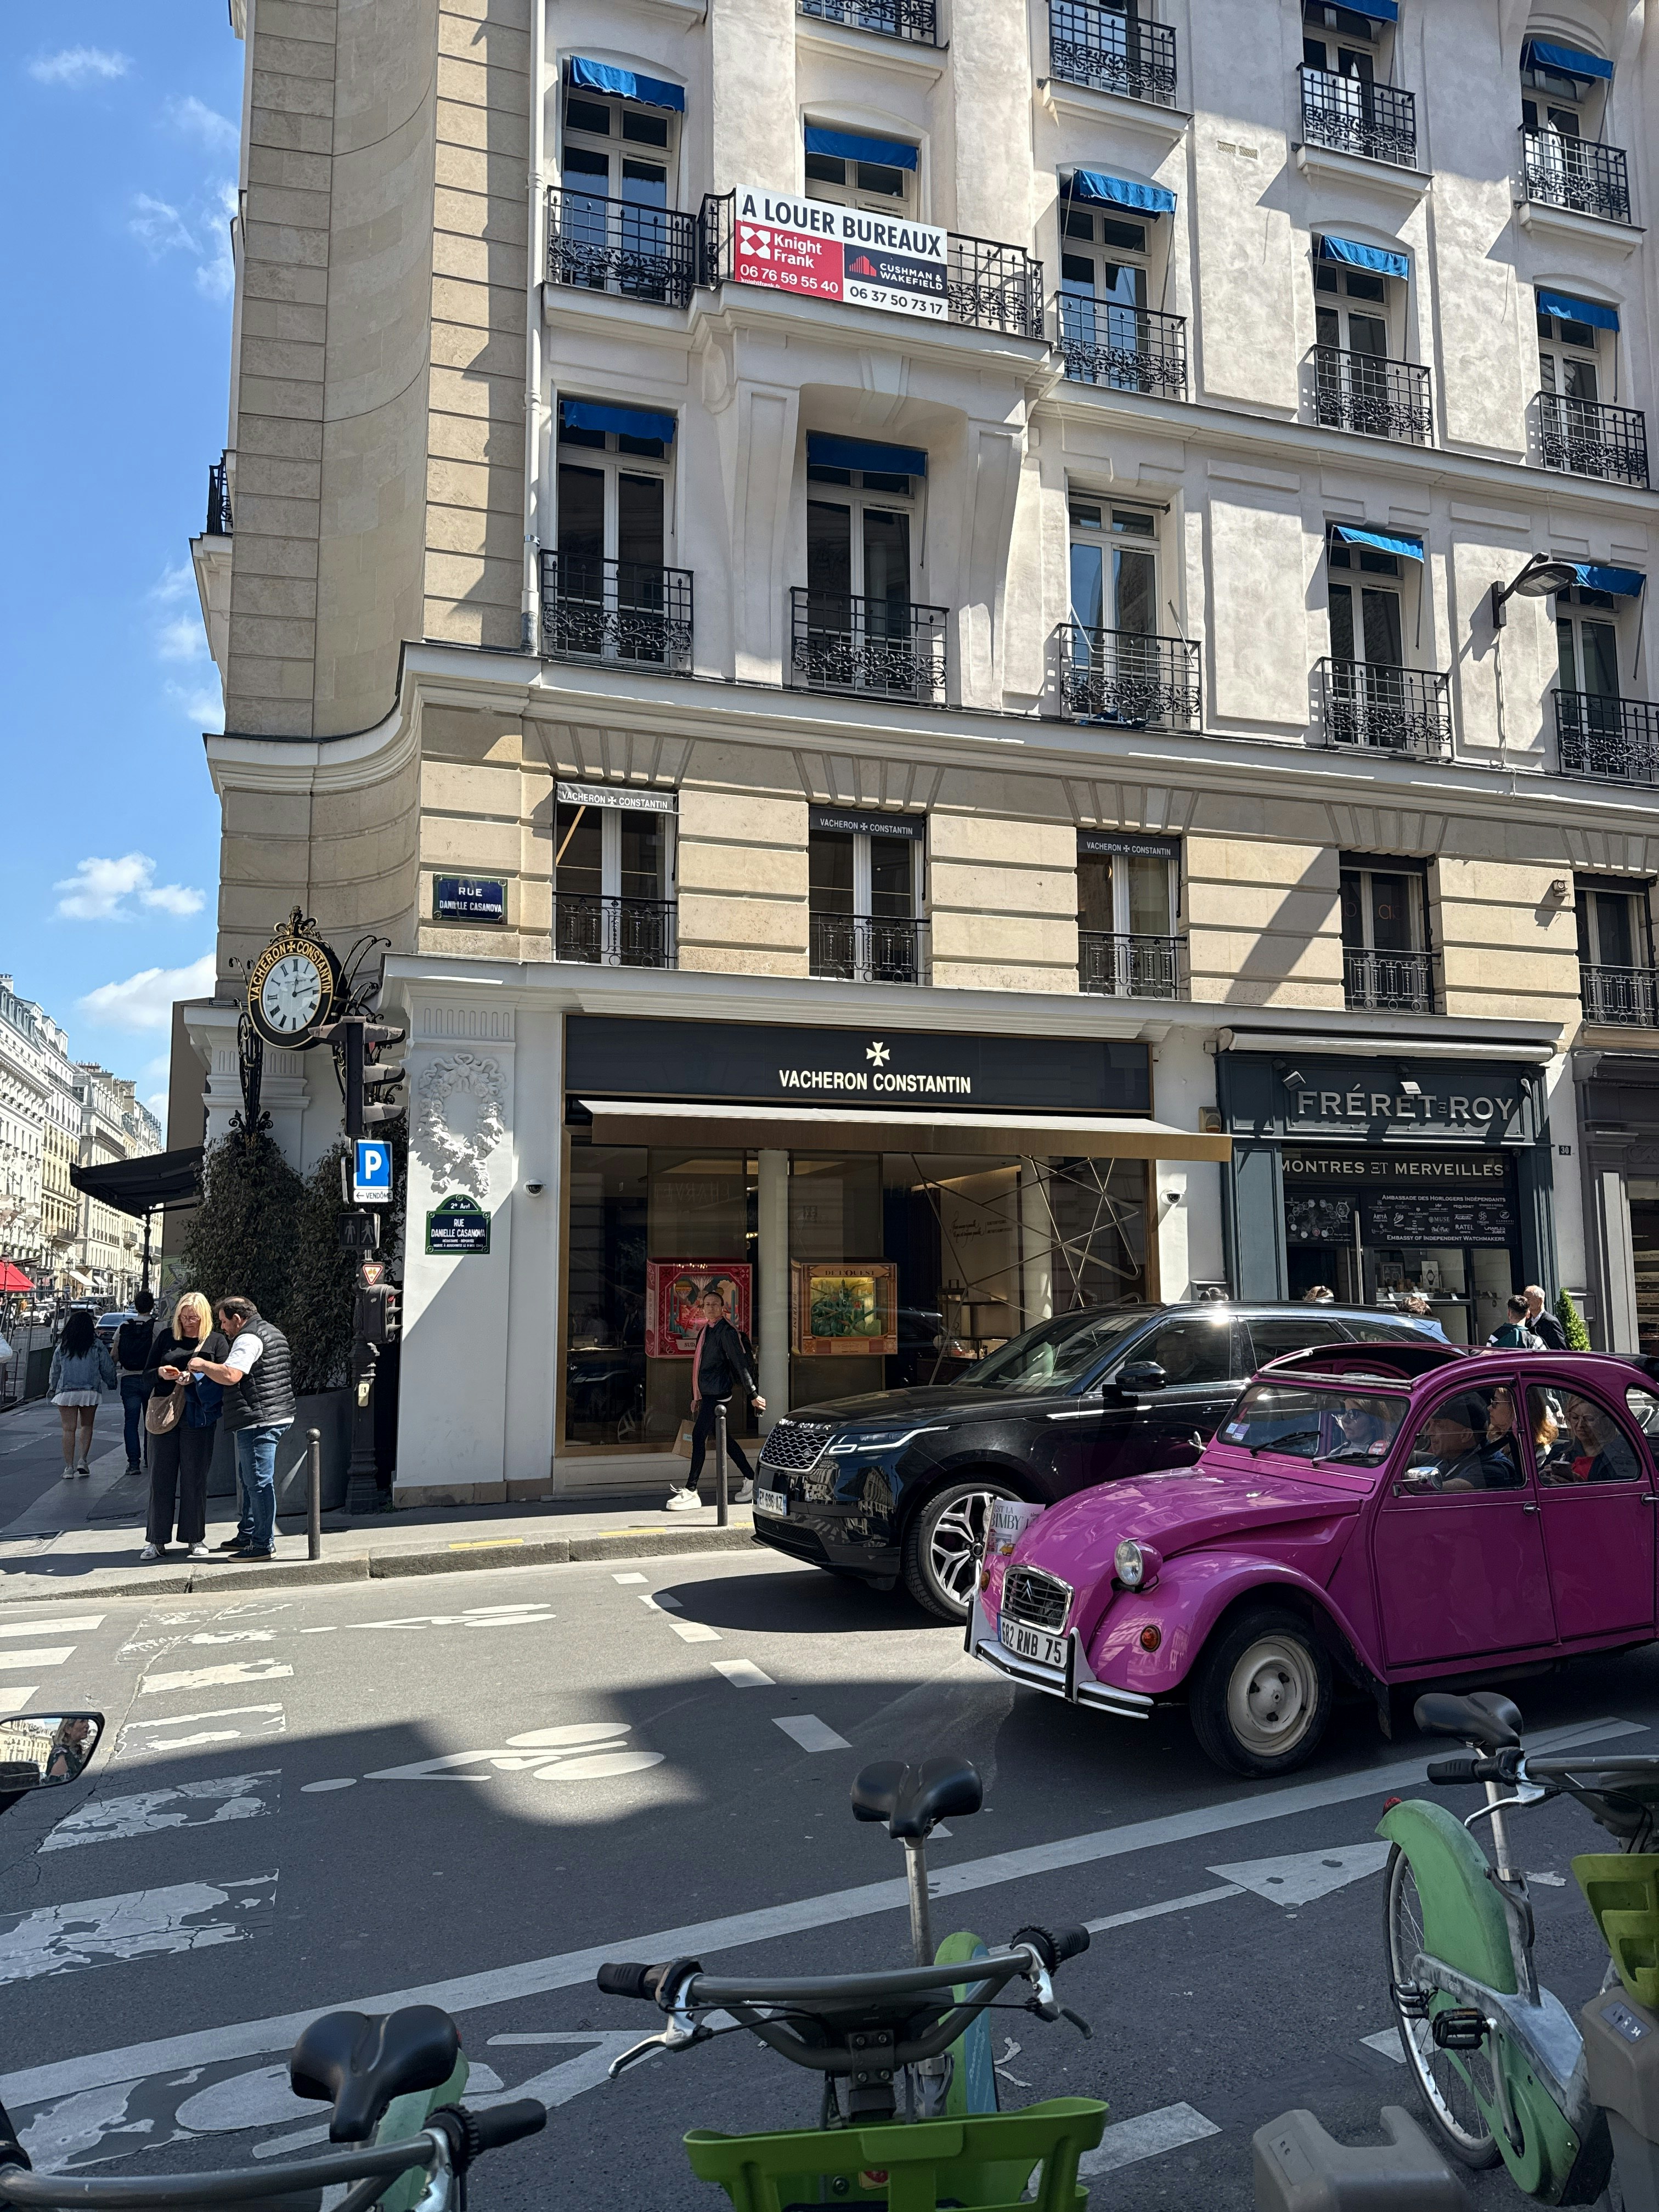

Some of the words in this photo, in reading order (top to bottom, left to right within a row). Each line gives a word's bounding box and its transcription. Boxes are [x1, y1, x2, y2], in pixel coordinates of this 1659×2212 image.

[742, 194, 756, 218] A
[765, 198, 834, 235] LOUER
[843, 216, 941, 257] BUREAUX
[774, 233, 822, 256] Knight
[774, 249, 815, 269] Frank
[741, 264, 758, 277] 06
[761, 268, 777, 281] 76
[781, 272, 797, 285] 59
[800, 275, 817, 289] 55
[821, 280, 838, 294] 40
[880, 263, 933, 280] CUSHMAN
[880, 271, 943, 290] WAKEFIELD
[850, 286, 867, 299] 06
[871, 290, 887, 303] 37
[891, 295, 907, 307] 50
[911, 298, 926, 312] 73
[929, 302, 943, 314] 17
[562, 791, 606, 803] VACHERON
[619, 798, 668, 809] CONSTANTIN
[820, 818, 858, 830] VACHERON
[870, 823, 913, 835] CONSTANTIN
[1086, 842, 1121, 851] VACHERON
[1132, 845, 1171, 855] CONSTANTIN
[459, 887, 483, 896] RUE
[470, 902, 502, 913] CASANOVA
[250, 943, 286, 1001] VACHERON
[297, 941, 331, 994] CONSTANTIN
[779, 1070, 867, 1090] VACHERON
[873, 1073, 971, 1093] CONSTANTIN
[1297, 1084, 1436, 1118] FRÉRET
[1449, 1096, 1514, 1120] ROY
[1561, 1146, 1570, 1154] 30
[365, 1150, 382, 1180] P
[1282, 1160, 1365, 1173] MONTRES
[1395, 1163, 1504, 1176] MERVEILLES
[454, 1218, 464, 1227] RUE
[431, 1229, 455, 1237] DANIELLE
[457, 1229, 485, 1237] CASANOVA
[1002, 1622, 1014, 1647] 682
[1017, 1629, 1038, 1656] RNB
[1045, 1638, 1062, 1663] 75
